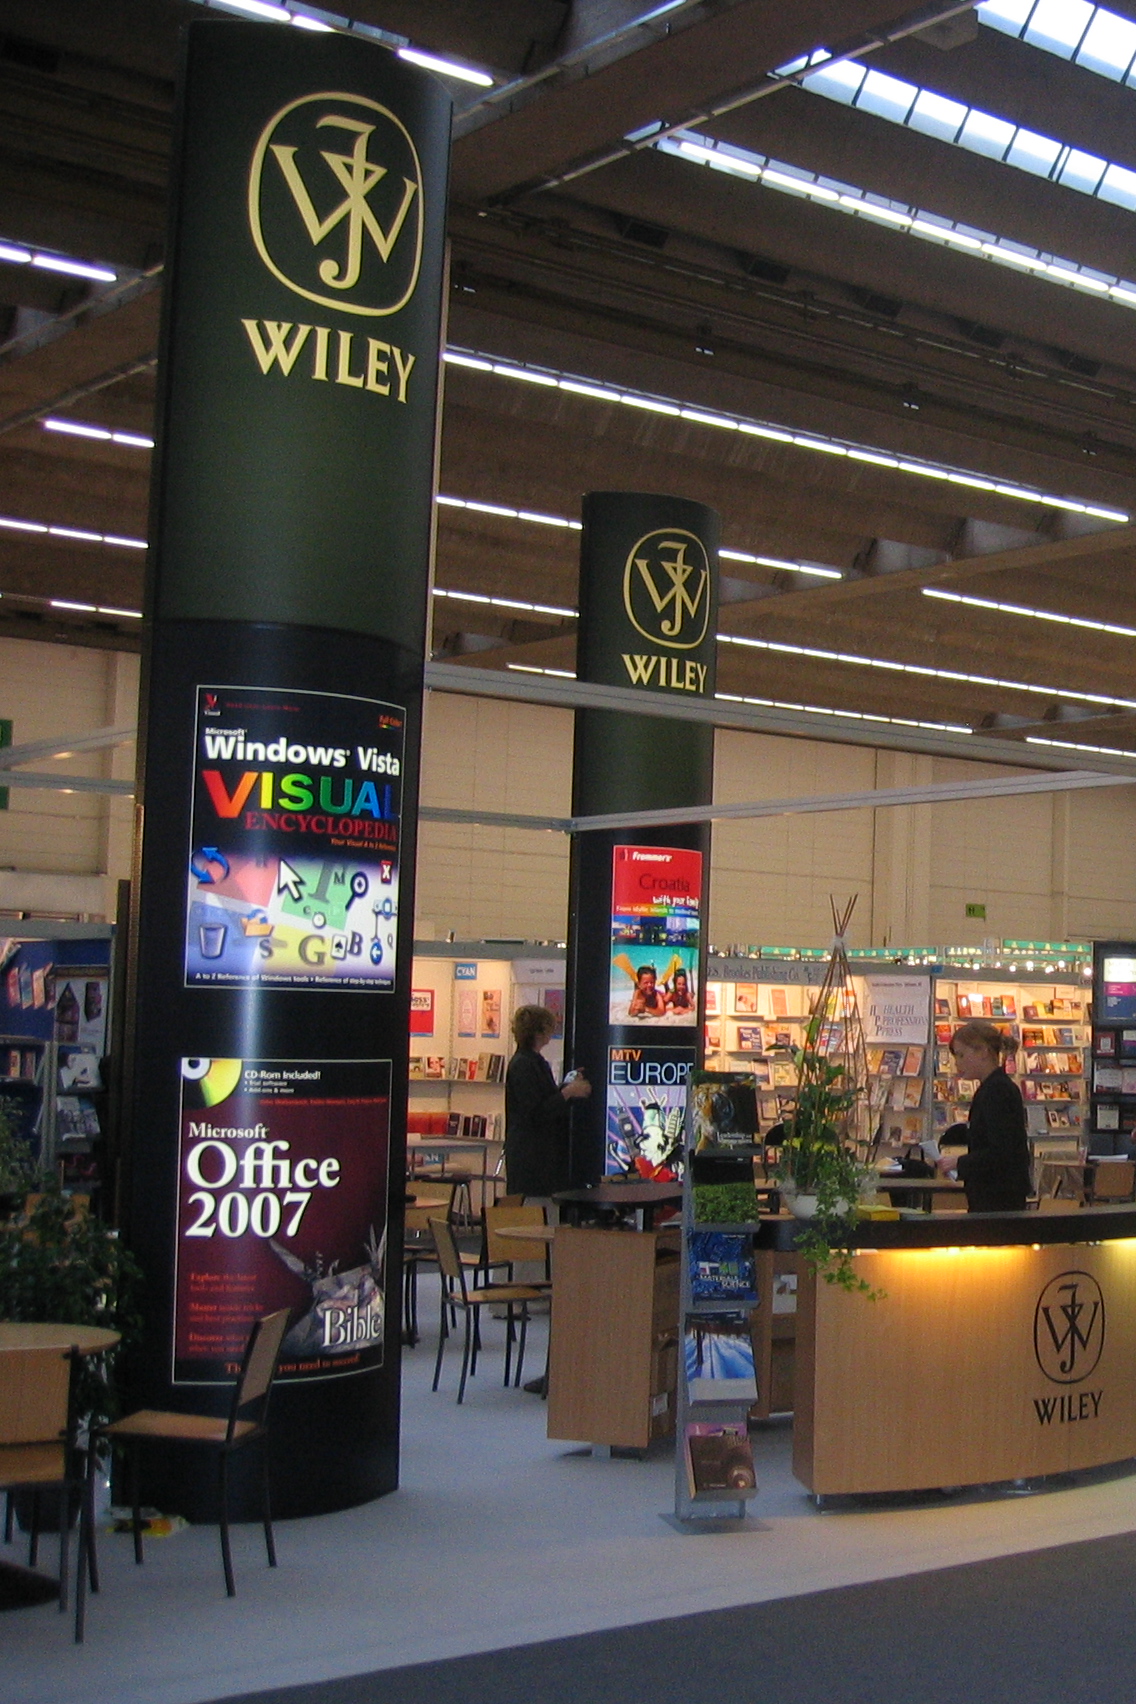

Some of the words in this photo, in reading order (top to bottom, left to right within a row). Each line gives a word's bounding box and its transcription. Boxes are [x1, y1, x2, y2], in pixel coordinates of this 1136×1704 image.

[241, 318, 417, 404] WILEY
[621, 653, 708, 694] WILEY
[205, 735, 349, 768] Windows
[357, 746, 400, 776] Vista
[202, 769, 398, 820] VISUAL
[244, 811, 398, 842] ENCYCLOPEDIA
[639, 873, 690, 893] Croatia
[611, 1049, 642, 1061] MTV
[188, 1121, 268, 1139] Microsoft
[187, 1140, 341, 1189] Office
[185, 1190, 312, 1238] 2007
[323, 1304, 382, 1347] Bible
[1033, 1390, 1104, 1426] WILEY
